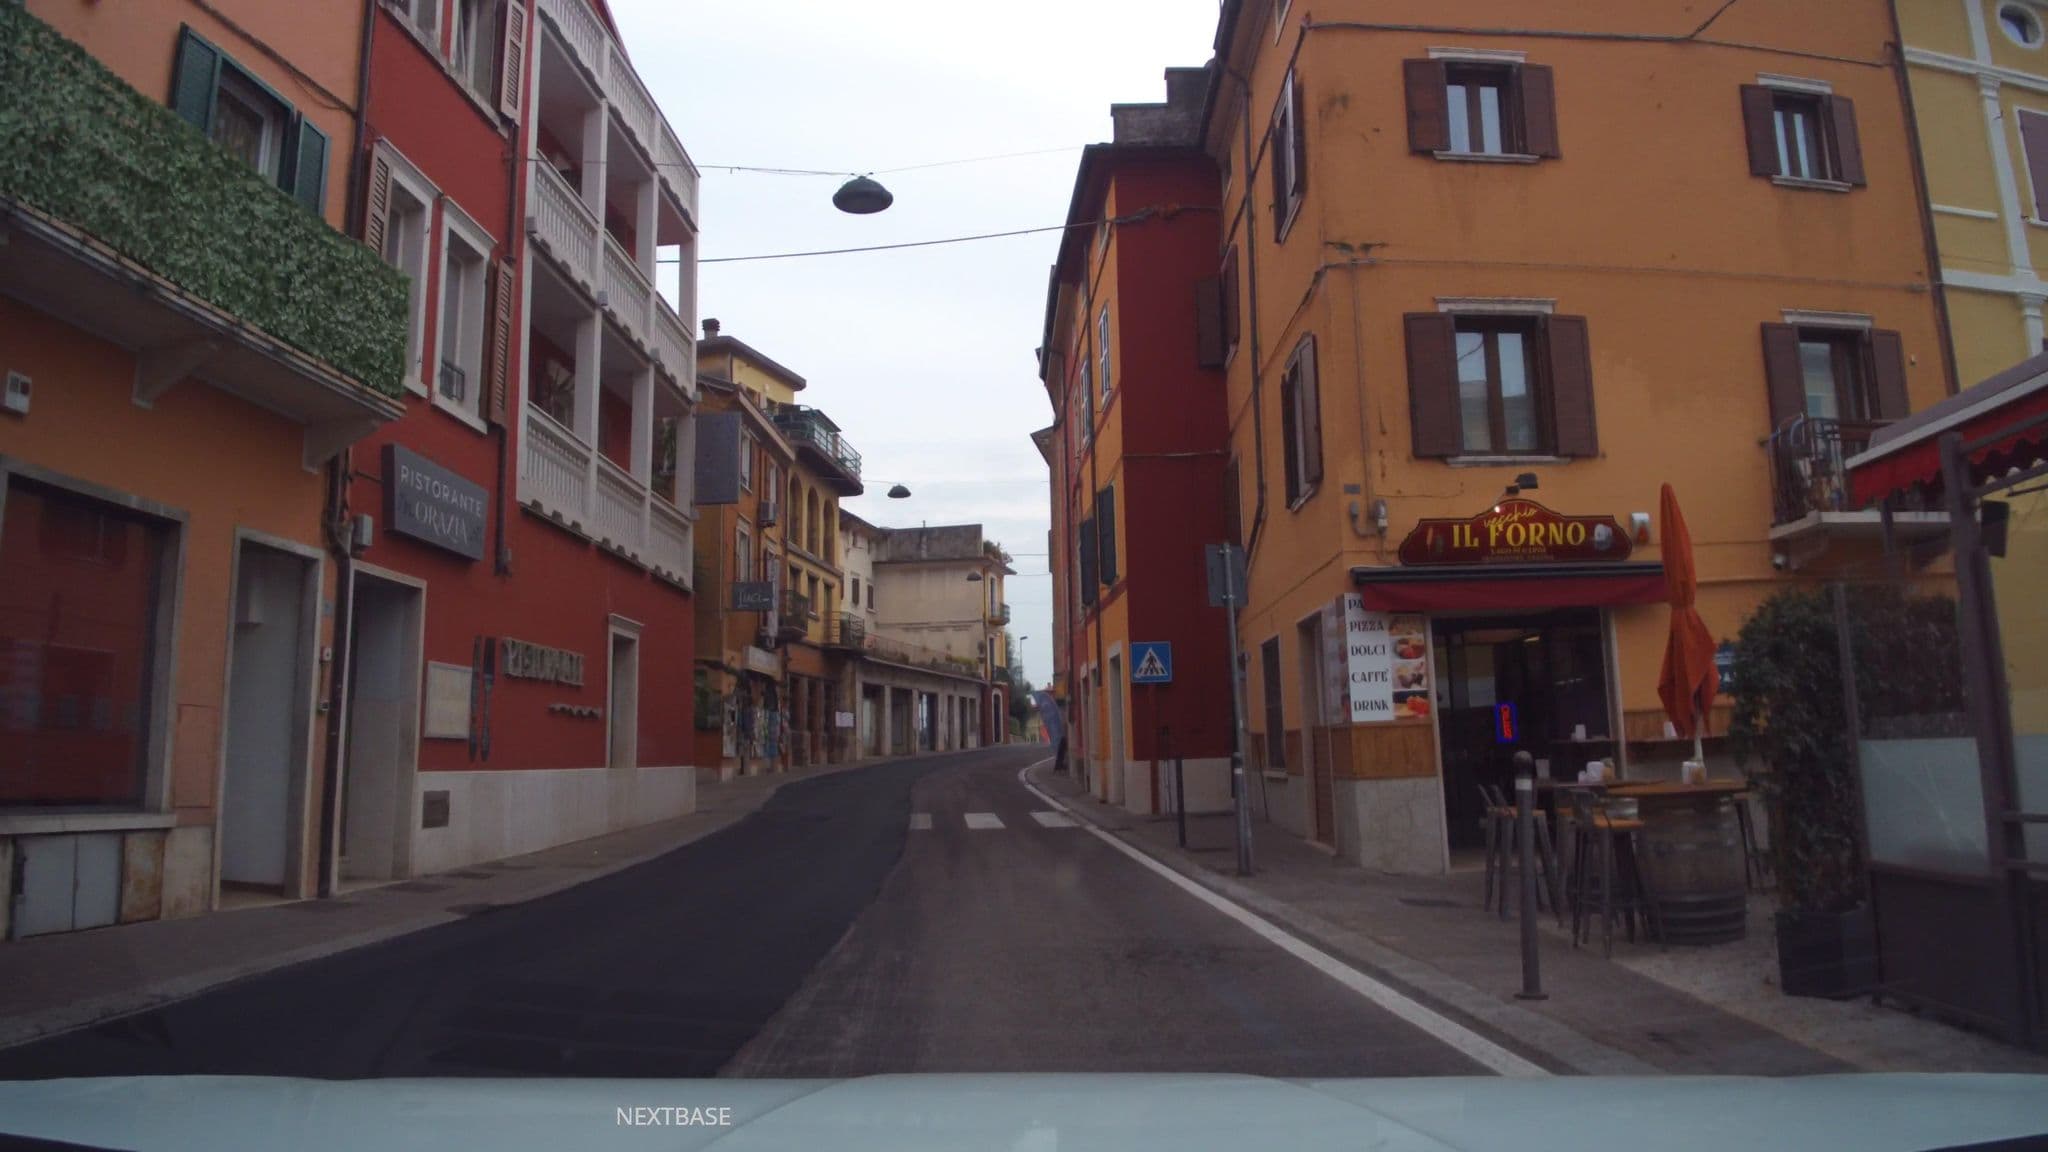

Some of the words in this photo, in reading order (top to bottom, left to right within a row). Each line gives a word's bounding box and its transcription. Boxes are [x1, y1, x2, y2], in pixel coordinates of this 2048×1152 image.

[401, 465, 482, 517] RISTORANTE
[1452, 523, 1479, 547] IL
[1489, 522, 1586, 547] FORNO
[1349, 619, 1385, 633] PIZZA
[1350, 644, 1386, 657] DOLCI
[1353, 698, 1389, 712] DRINK
